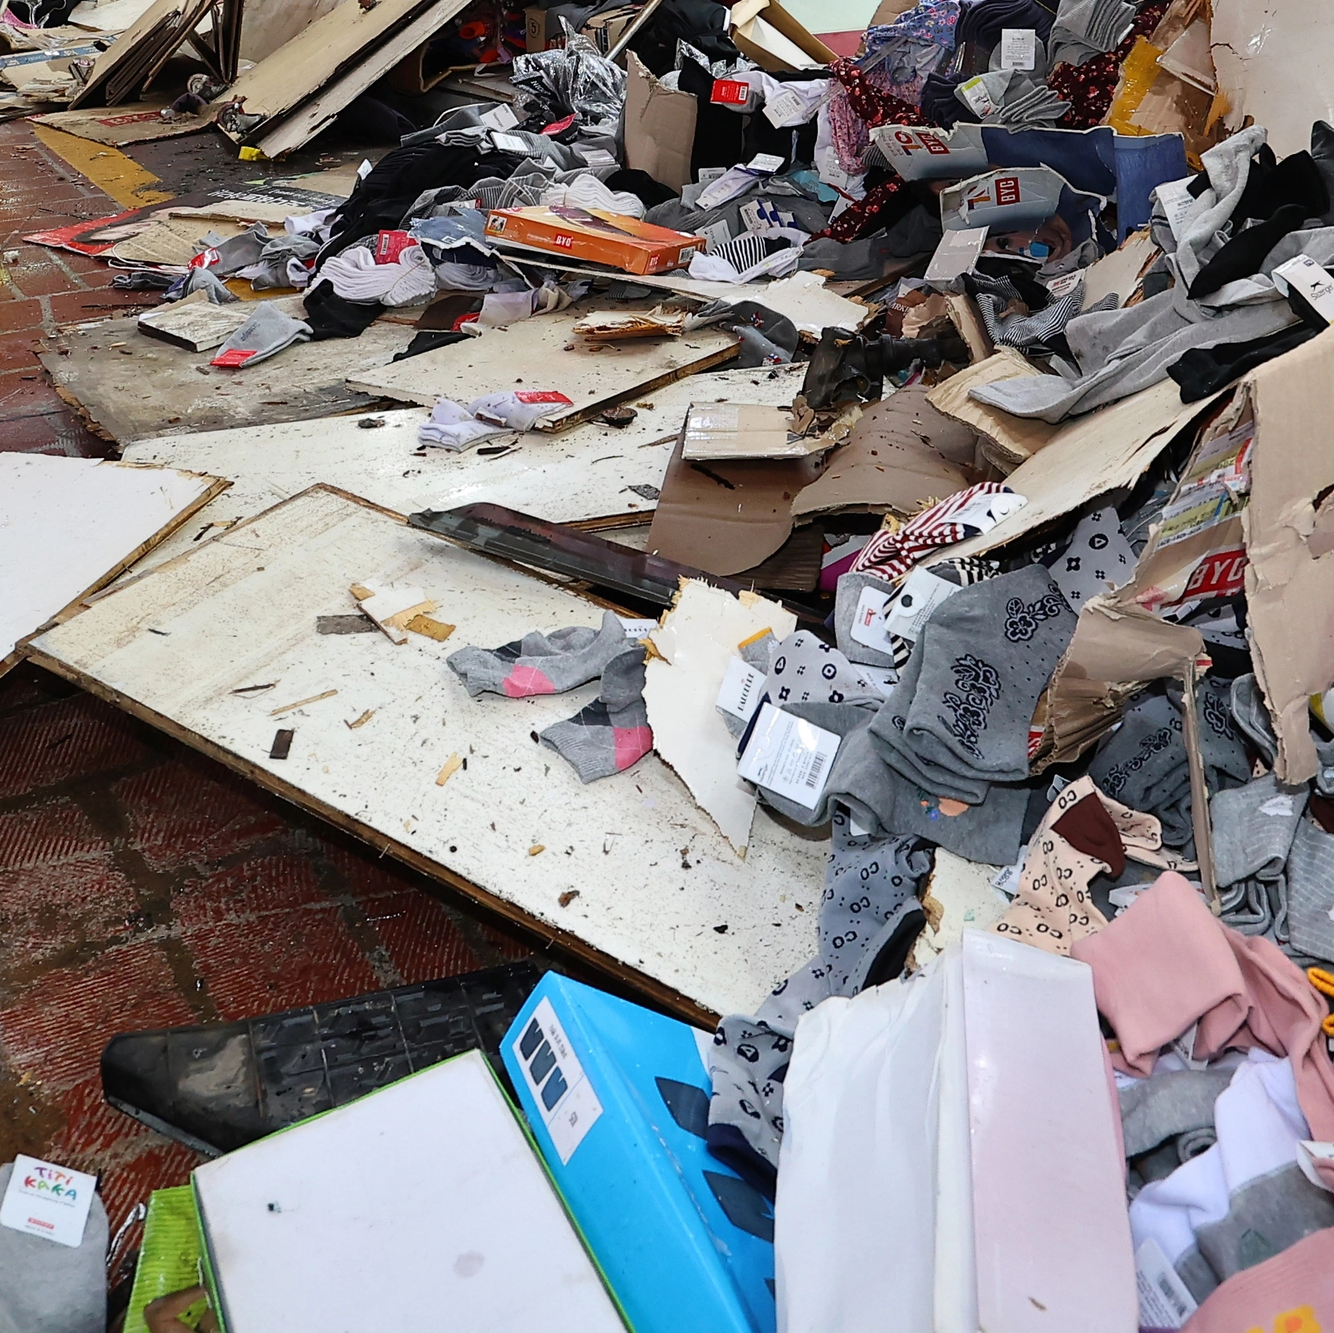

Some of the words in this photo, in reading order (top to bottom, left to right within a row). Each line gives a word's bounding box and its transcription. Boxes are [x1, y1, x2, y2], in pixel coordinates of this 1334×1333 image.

[1001, 179, 1016, 203] BYC
[555, 235, 572, 248] BYC
[1188, 557, 1244, 591] BYC
